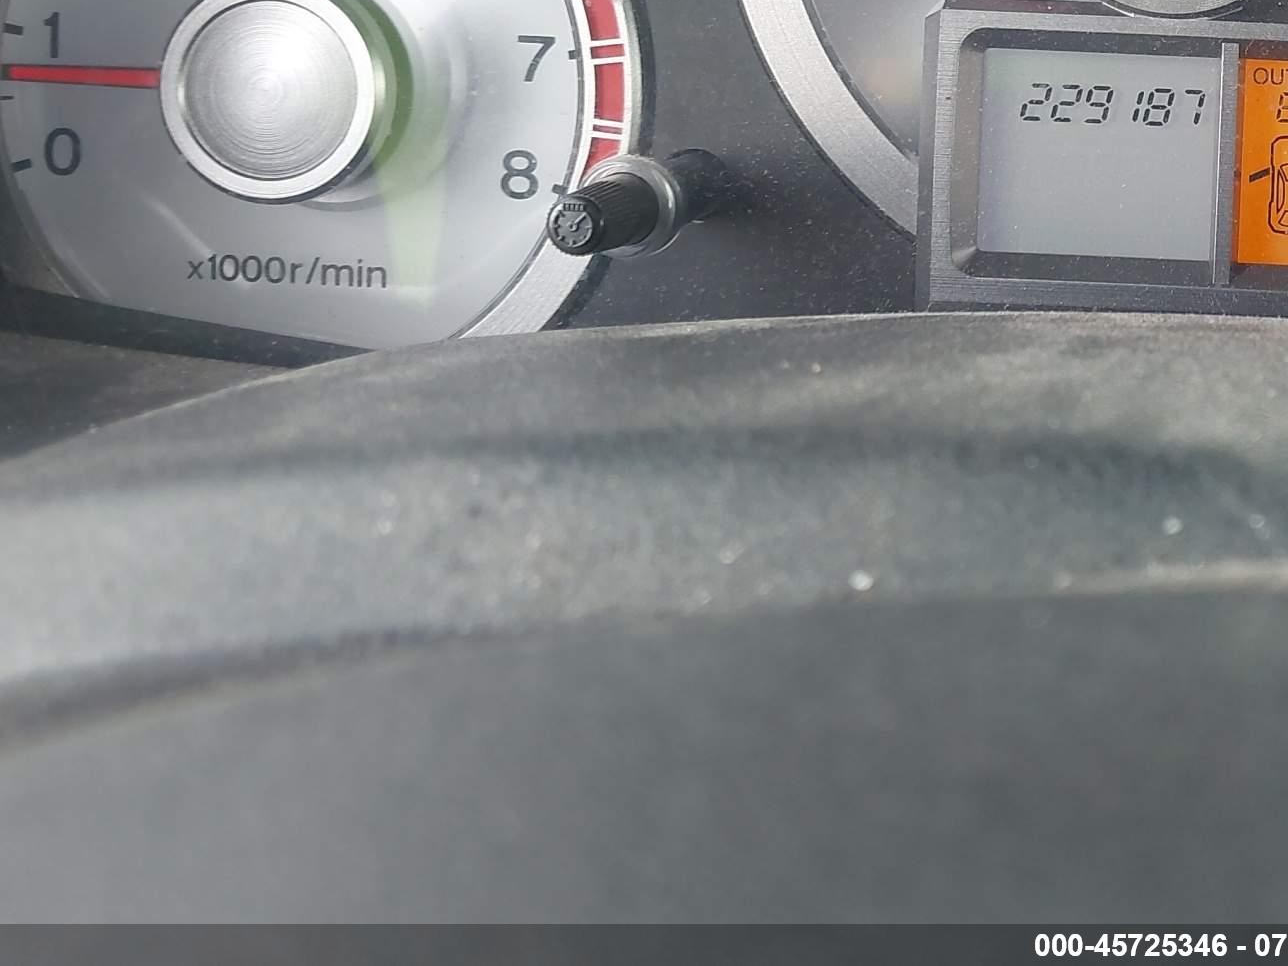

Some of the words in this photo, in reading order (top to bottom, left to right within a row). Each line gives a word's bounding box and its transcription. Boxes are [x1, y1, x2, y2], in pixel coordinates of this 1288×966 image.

[43, 12, 59, 57] 1
[517, 36, 555, 81] 7
[1020, 82, 1206, 127] 229187
[44, 128, 81, 175] 0
[500, 150, 538, 200] 8
